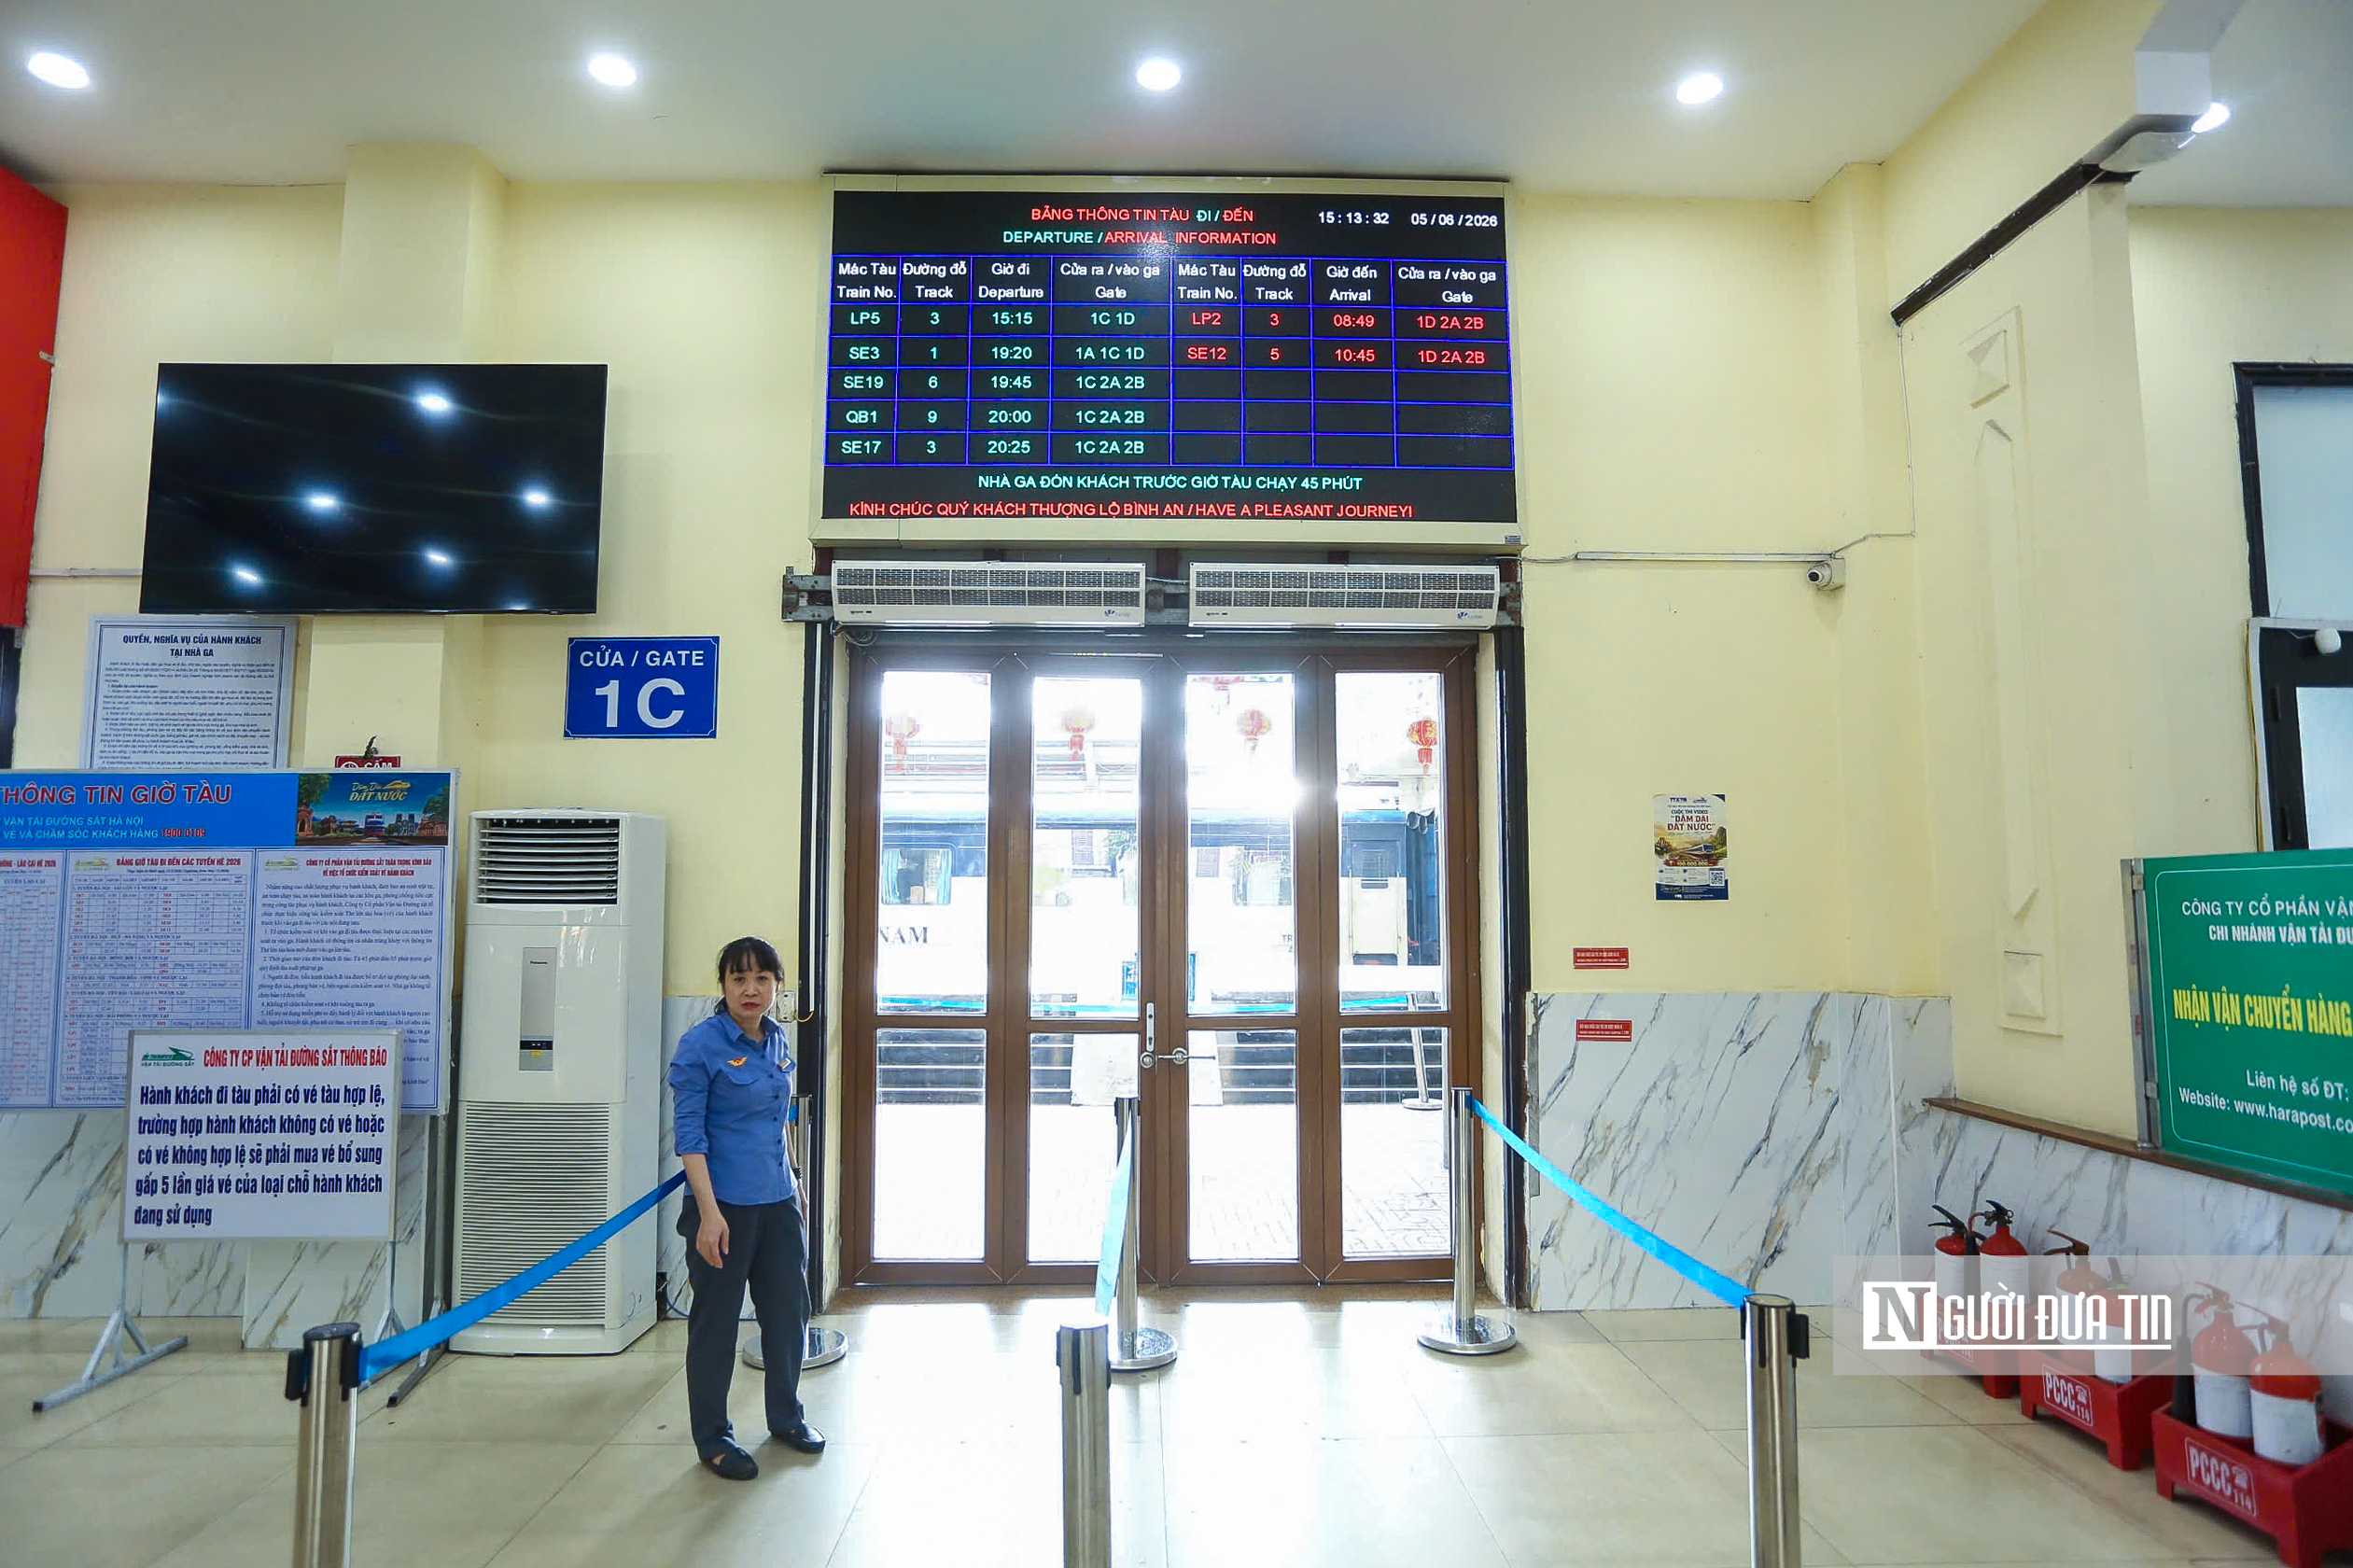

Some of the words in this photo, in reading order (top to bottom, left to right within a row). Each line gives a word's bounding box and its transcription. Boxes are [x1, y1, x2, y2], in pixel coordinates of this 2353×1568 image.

[1077, 205, 1129, 221] THÔNG
[1133, 209, 1156, 221] TIN
[1160, 206, 1189, 221] TÀU
[1197, 209, 1212, 221] ĐI
[1222, 206, 1254, 222] ĐẾN
[1003, 231, 1093, 244] DEPARTURE
[1105, 232, 1167, 245] ARRIVAL
[1175, 231, 1276, 245] INFORMATION
[837, 286, 871, 299] Train
[874, 286, 897, 299] No.
[916, 286, 953, 299] Track
[978, 286, 1044, 301] Departure
[1095, 287, 1127, 299] Gate
[850, 312, 880, 325] LP5
[930, 312, 940, 325] 3
[991, 312, 1033, 326] 15:15
[1090, 312, 1111, 325] 1C
[1115, 312, 1135, 325] 1D
[1192, 312, 1221, 326] LP2
[1269, 313, 1280, 326] 3
[1333, 314, 1375, 328] 08:49
[1417, 315, 1436, 329] 1D
[1439, 315, 1461, 329] 2A
[1464, 316, 1484, 329] 2B
[848, 346, 880, 359] SE3
[931, 346, 938, 359] 1
[991, 346, 1032, 359] 19:20
[1075, 346, 1095, 359] 1A
[1099, 346, 1121, 360] 1C
[1125, 346, 1144, 359] 1D
[978, 473, 1010, 488] NHÀ
[1015, 475, 1036, 488] GA
[1040, 473, 1072, 488] ĐÓN
[1077, 473, 1129, 489] KHÁCH
[1133, 472, 1187, 489] TRƯỚC
[1191, 473, 1218, 489] GIỜ
[1222, 474, 1252, 489] TÀU
[1255, 476, 1297, 492] CHẠY
[1300, 477, 1318, 490] 45
[1322, 475, 1363, 490] PHÚT
[849, 501, 885, 516] KÍNH
[889, 500, 932, 516] CHÚC
[937, 500, 970, 516] QUÝ
[973, 501, 1026, 516] KHÁCH
[1029, 502, 1096, 519] THƯỢNG
[1099, 501, 1120, 519] LỘ
[1124, 502, 1158, 516] BÌNH
[1163, 504, 1184, 516] AN
[1196, 504, 1236, 516] HAVE
[1240, 504, 1252, 516] A
[1254, 504, 1333, 517] PLEASANT
[1337, 505, 1413, 518] JOURNEY!
[154, 634, 178, 644] NGHĨA
[180, 635, 190, 645] VỤ
[193, 633, 209, 644] CỦA
[211, 634, 232, 644] HÀNH
[234, 635, 261, 644] KHÁCH
[171, 649, 183, 658] TẠI
[185, 648, 201, 657] NHÀ
[203, 649, 214, 657] GA
[580, 645, 624, 666] CỬA
[645, 651, 704, 666] GATE
[595, 678, 685, 728] 1C
[83, 784, 123, 805] TIN
[131, 779, 177, 805] GIỜ
[182, 780, 232, 805] TÀU
[2181, 897, 2221, 917] CÔNG
[2225, 901, 2244, 917] TY
[2248, 893, 2271, 917] CỔ
[2275, 893, 2319, 917] PHẦN
[2208, 924, 2229, 942] CHI
[2232, 921, 2276, 943] NHÁNH
[2278, 922, 2306, 946] VẬN
[2309, 920, 2332, 945] TẢI
[2173, 983, 2210, 1028] NHẬN
[2212, 985, 2241, 1031] VẬN
[2244, 983, 2304, 1032] CHUYỂN
[2305, 992, 2352, 1037] HÀNG
[203, 1045, 228, 1067] CÔNG
[230, 1049, 240, 1067] TY
[242, 1049, 254, 1067] CP
[256, 1045, 273, 1071] VẬN
[274, 1042, 288, 1067] TẢI
[289, 1043, 319, 1067] ĐƯỜNG
[321, 1043, 339, 1067] SẮT
[340, 1043, 368, 1067] THÔNG
[370, 1043, 387, 1067] BÁO
[2246, 1069, 2276, 1089] Liên
[2279, 1073, 2297, 1095] hệ
[2301, 1076, 2319, 1098] số
[2323, 1080, 2349, 1101] ĐT:
[140, 1085, 172, 1105] Hành
[175, 1085, 213, 1105] khách
[216, 1085, 228, 1104] đi
[231, 1085, 251, 1104] tàu
[254, 1083, 281, 1106] phải
[285, 1085, 300, 1104] có
[303, 1084, 317, 1104] vé
[321, 1085, 340, 1104] tàu
[343, 1085, 366, 1108] hợp
[370, 1084, 385, 1108] lệ,
[2178, 1086, 2231, 1112] Website:
[138, 1113, 177, 1136] trường
[180, 1114, 203, 1139] hợp
[205, 1113, 235, 1134] hành
[239, 1113, 276, 1134] khách
[279, 1113, 316, 1135] không
[319, 1113, 335, 1133] có
[338, 1113, 352, 1133] vé
[355, 1113, 385, 1137] hoặc
[133, 1205, 163, 1226] đang
[166, 1202, 181, 1225] sử
[183, 1205, 213, 1228] dụng
[2044, 1370, 2077, 1411] PCCC
[2076, 1405, 2090, 1421] 114
[2189, 1446, 2232, 1496] PCCC
